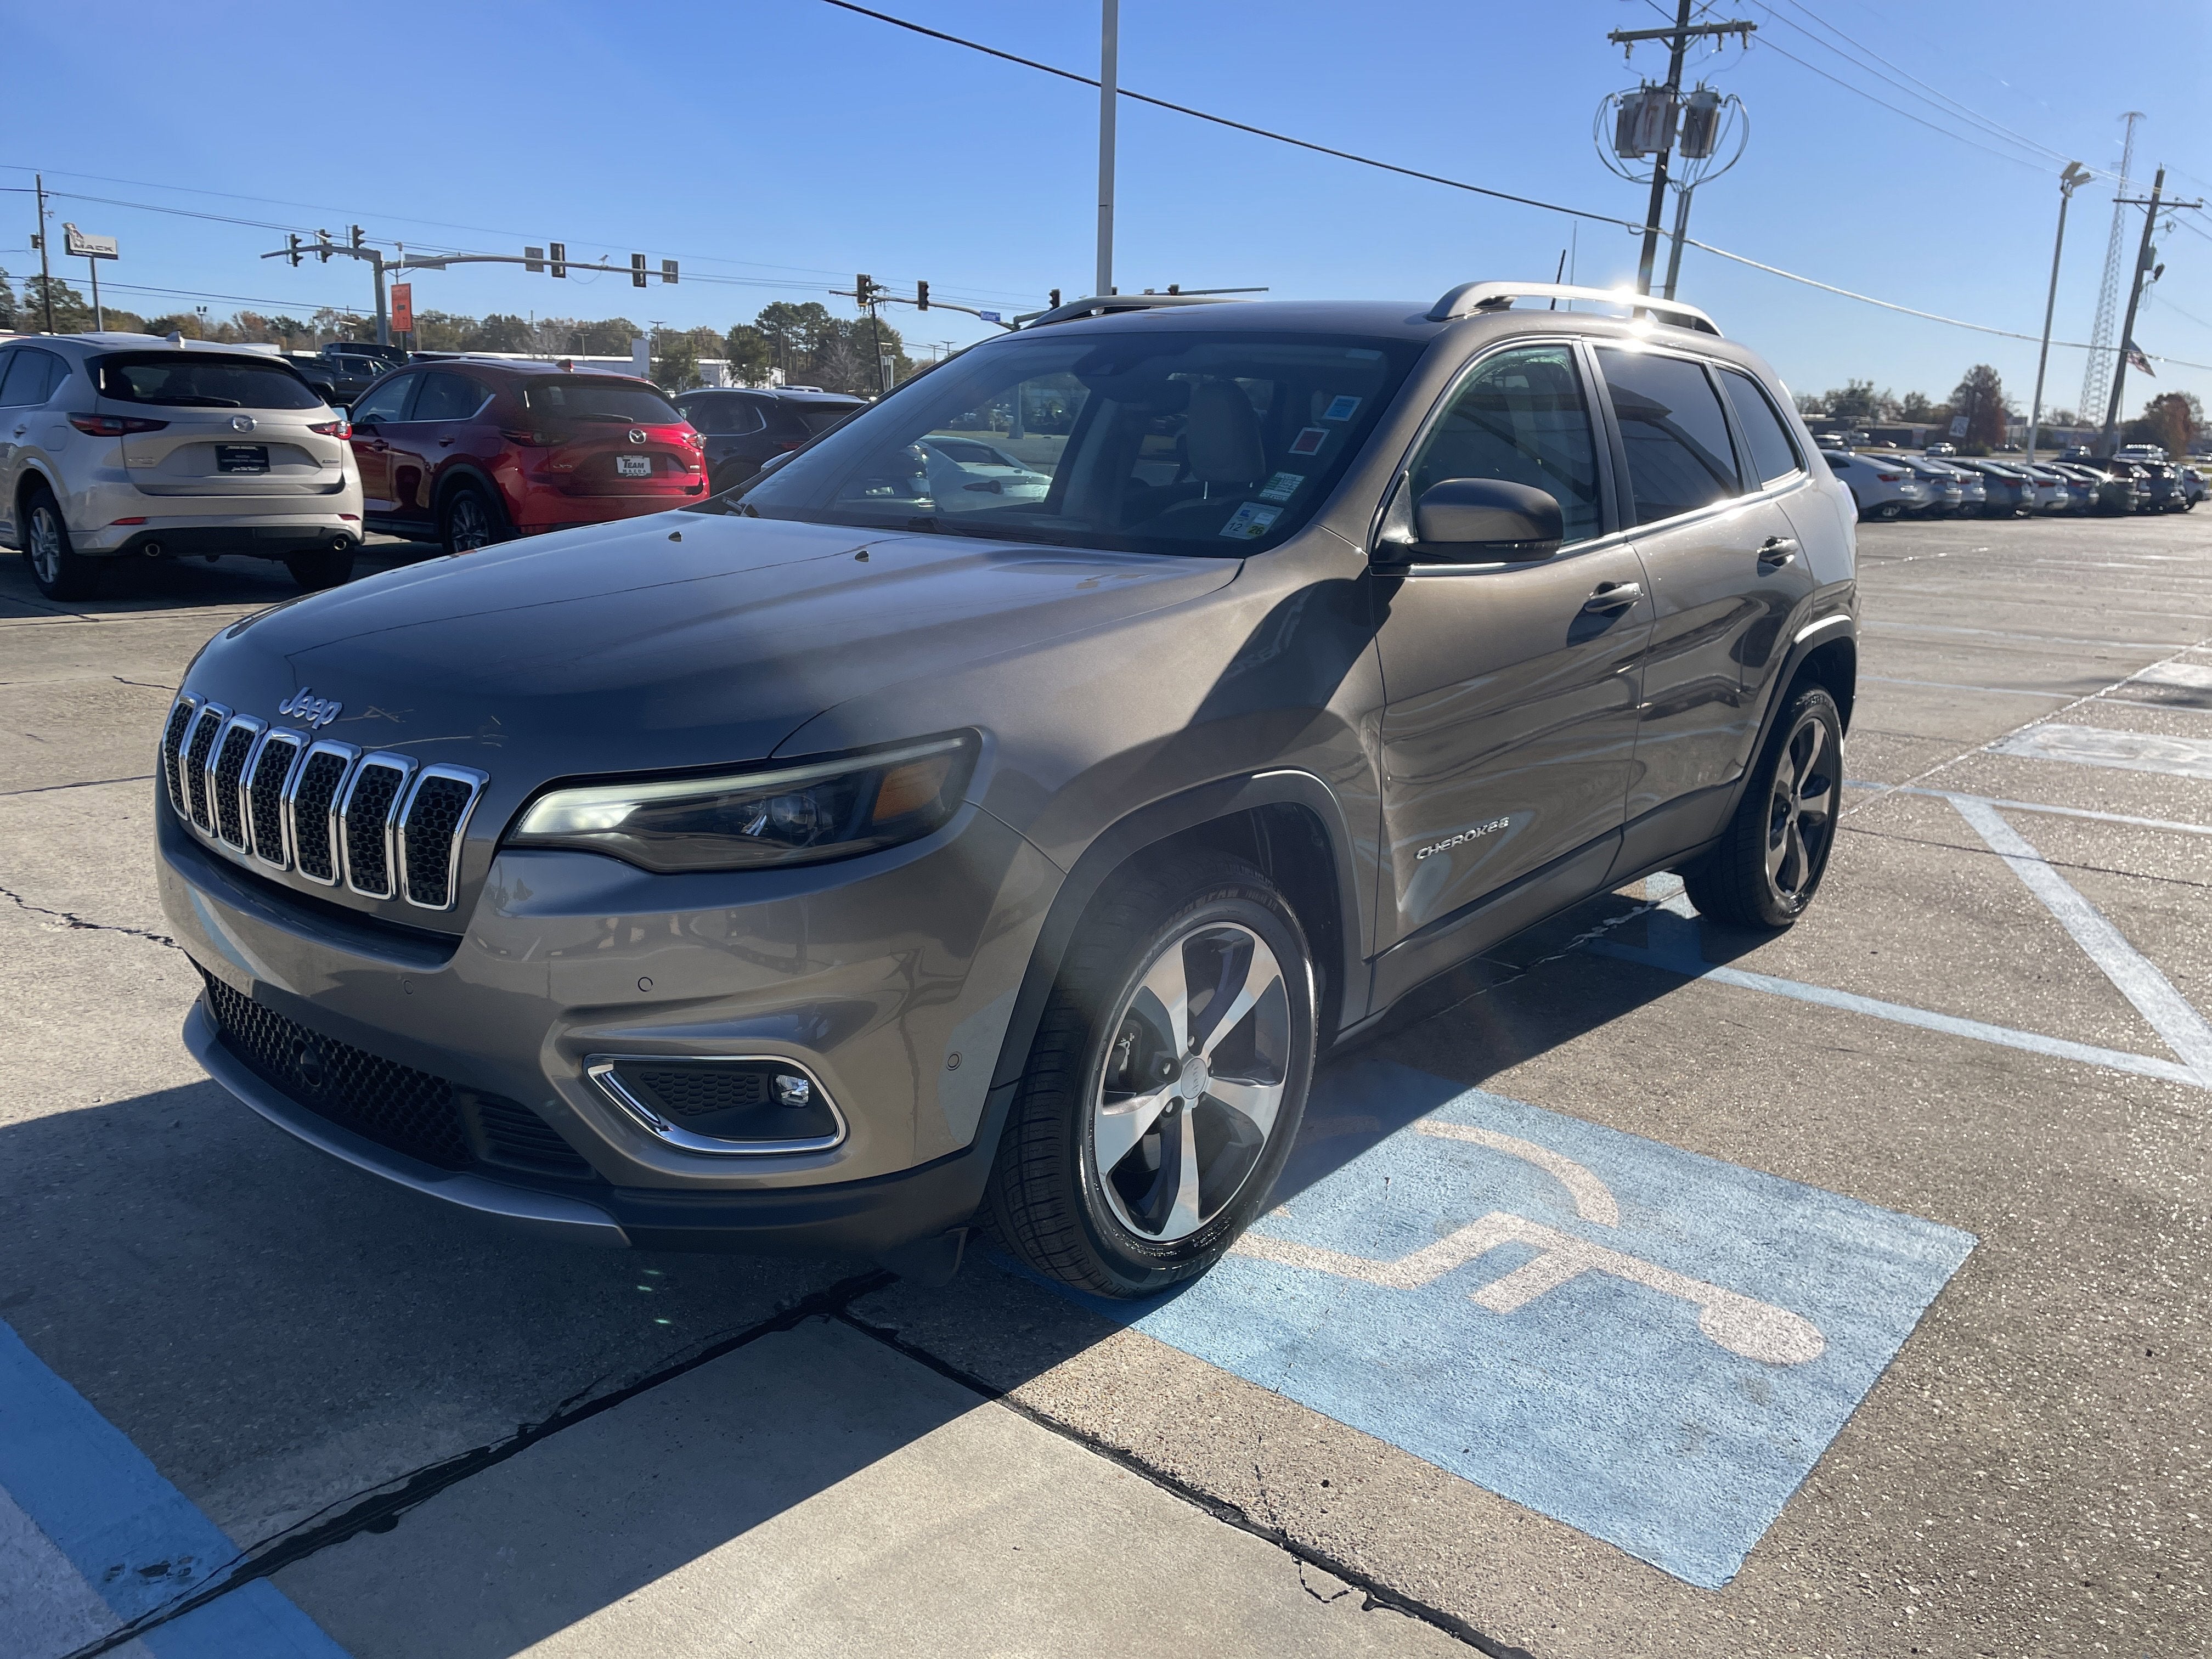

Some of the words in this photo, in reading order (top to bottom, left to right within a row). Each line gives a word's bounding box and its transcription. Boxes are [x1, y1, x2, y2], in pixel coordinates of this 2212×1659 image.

[74, 243, 114, 252] MACK
[622, 459, 644, 469] TEAM
[1229, 522, 1243, 532] 12
[1248, 526, 1265, 535] 26
[279, 686, 342, 730] Jeep
[1414, 816, 1509, 860] CHEROKEE
